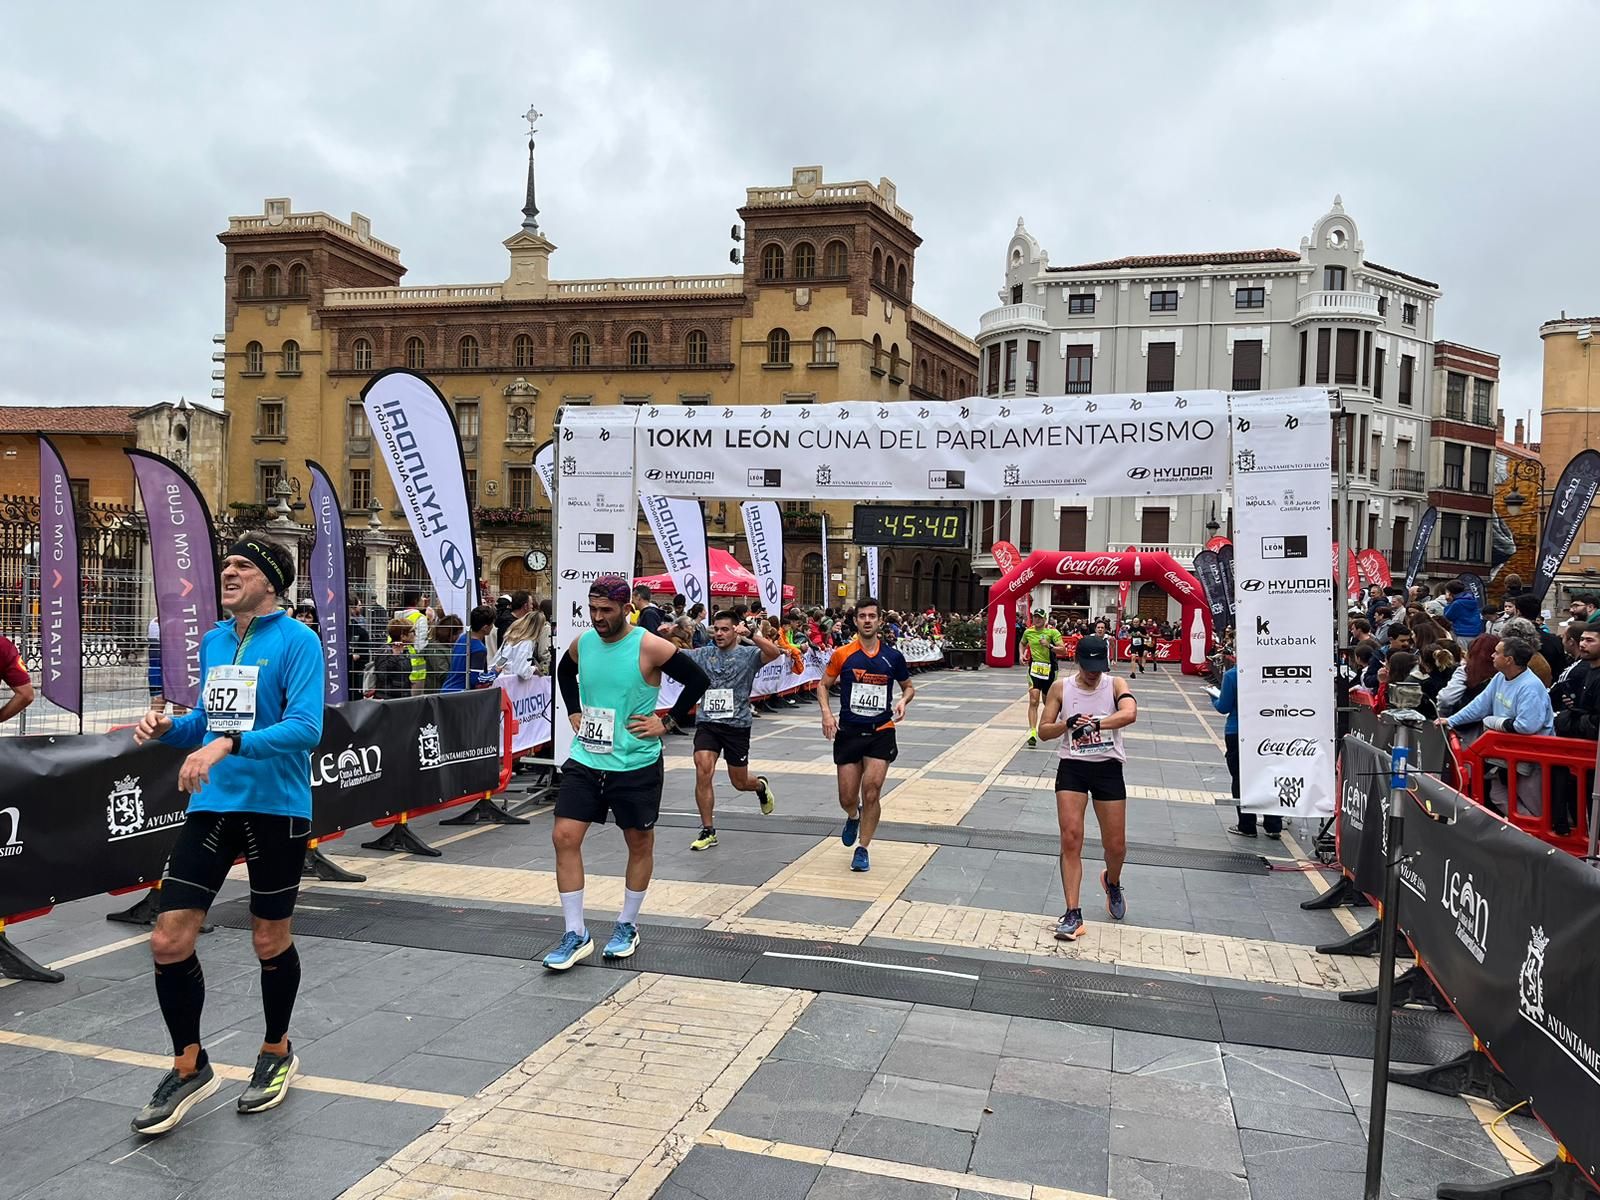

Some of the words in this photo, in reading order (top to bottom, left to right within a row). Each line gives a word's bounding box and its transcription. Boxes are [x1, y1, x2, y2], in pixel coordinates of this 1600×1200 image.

[647, 428, 712, 448] 10KM
[725, 425, 789, 448] LEÓN
[798, 430, 872, 448] CUNA
[880, 430, 926, 450] DEL
[936, 420, 1214, 450] PARLAMENTARISMO
[666, 470, 714, 480] HYUNDAI
[1154, 466, 1213, 478] HYUNDAI
[1558, 508, 1585, 560] AYUNTAMIENTO
[1056, 555, 1124, 576] Coca-Cola
[1008, 568, 1034, 592] Coca-Cola
[1164, 571, 1196, 594] Coca-Cola
[1268, 579, 1330, 589] HYUNDAI
[572, 601, 582, 618] k
[1256, 616, 1270, 635] k
[1256, 635, 1316, 646] kutxabank
[208, 688, 238, 712] 952
[709, 699, 726, 711] 562
[859, 694, 879, 707] 440
[1260, 704, 1316, 717] emico
[476, 748, 484, 756] DE
[484, 746, 497, 755] LEÓN
[1257, 738, 1319, 757] Coca-Cola
